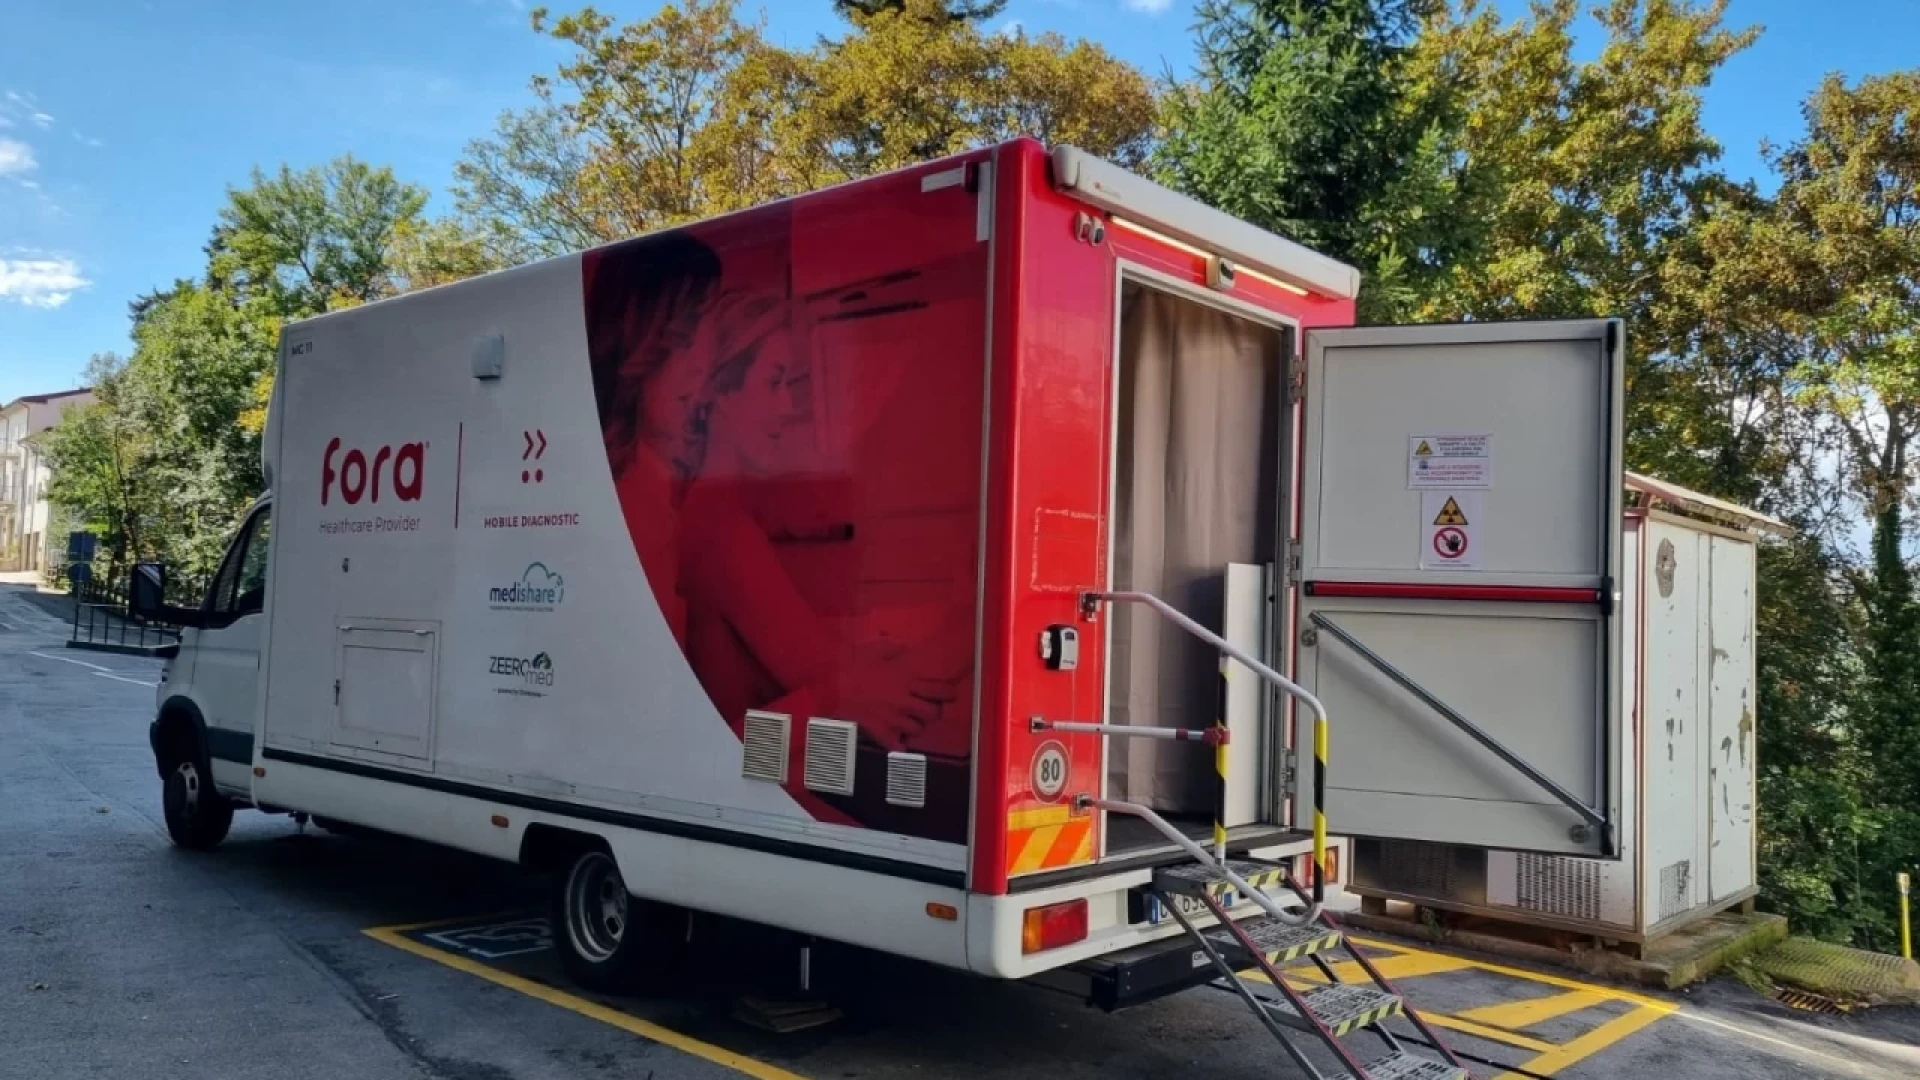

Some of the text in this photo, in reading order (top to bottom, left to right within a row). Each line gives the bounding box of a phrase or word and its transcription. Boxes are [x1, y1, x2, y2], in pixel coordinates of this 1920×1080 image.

[321, 437, 424, 506] fora
[319, 515, 421, 534] Healthcare Provider
[484, 512, 580, 528] MOBILE DIAGNOSTIC
[489, 581, 555, 603] medishare
[1041, 758, 1060, 783] 80
